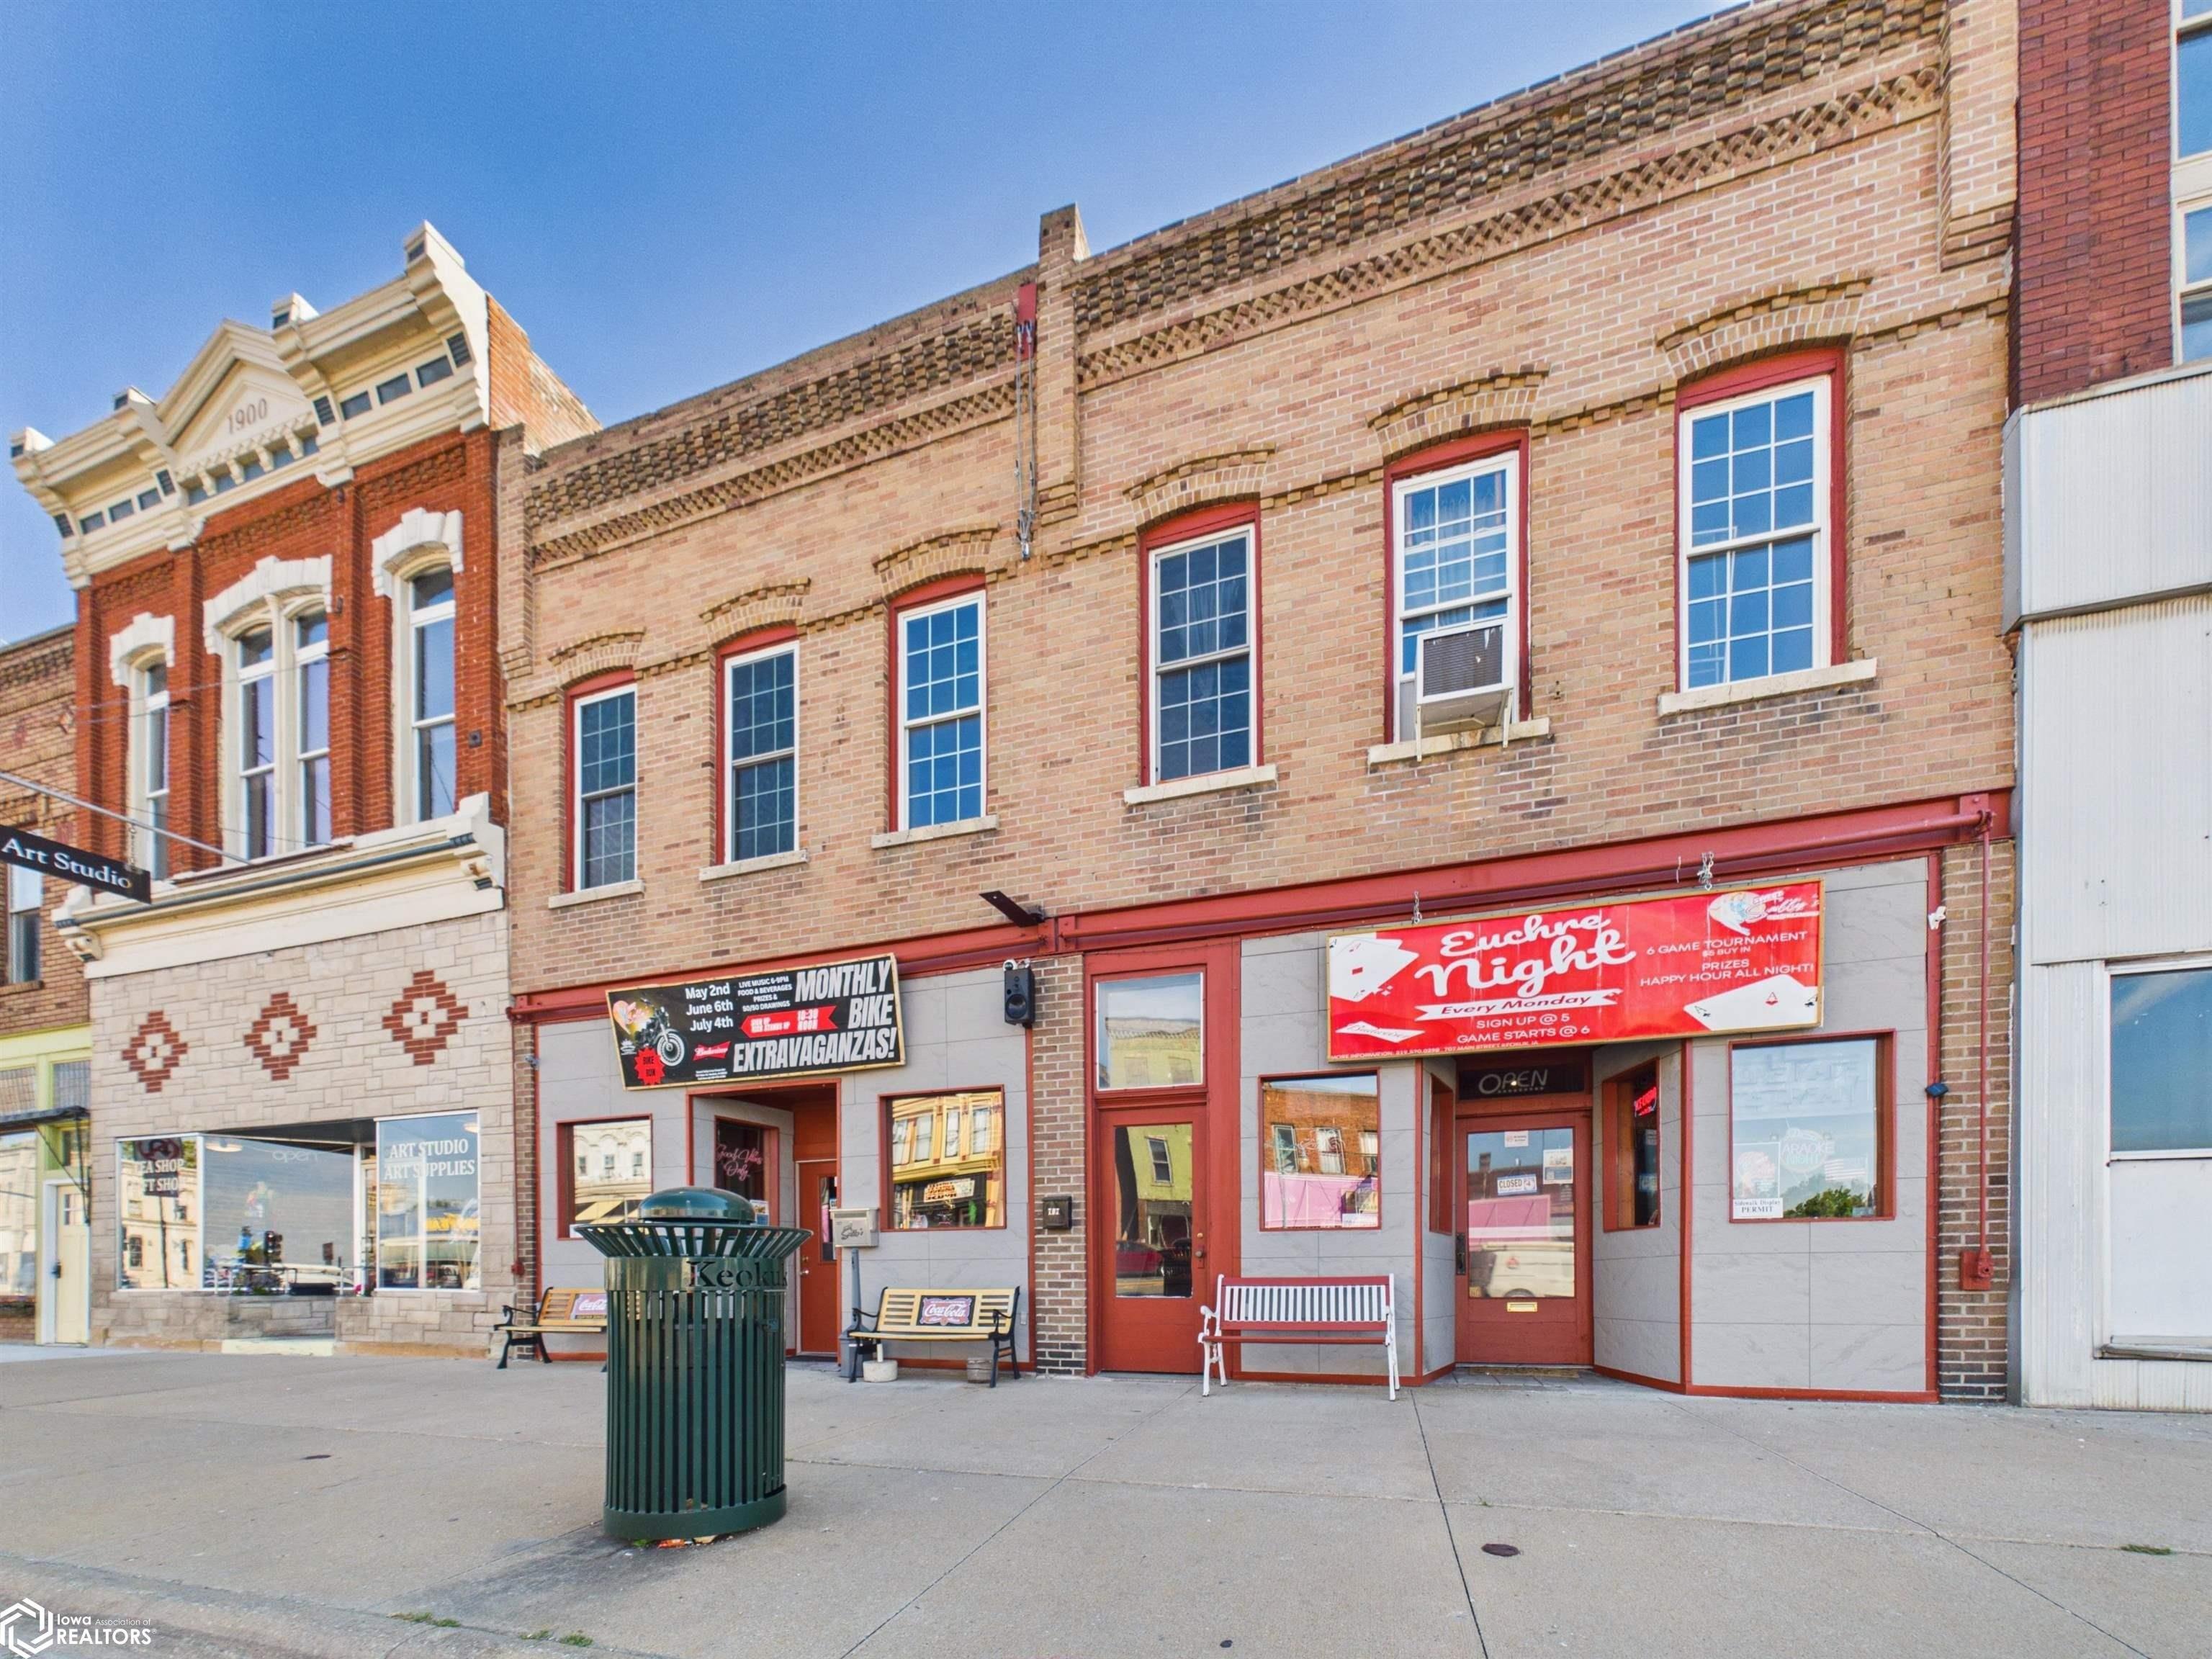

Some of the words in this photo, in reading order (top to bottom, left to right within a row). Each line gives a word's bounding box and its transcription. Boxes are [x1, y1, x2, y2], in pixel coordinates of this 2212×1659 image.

[228, 398, 267, 434] 1900
[1, 838, 48, 864] Art
[54, 852, 133, 888] Studio
[1440, 914, 1611, 956] Euchre
[1646, 947, 1655, 956] 6
[1658, 941, 1700, 954] GAME
[1704, 931, 1808, 950] TOURNAMENT
[1640, 974, 1686, 986] HAPPY
[1690, 971, 1732, 981] HOUR
[1735, 968, 1760, 978] ALL
[1764, 963, 1814, 975] NIGHT!
[1702, 958, 1750, 971] PRIZES
[685, 987, 707, 1000] May
[709, 983, 730, 996] 2nd
[752, 978, 770, 986] MUSIC
[759, 984, 793, 994] BEVERAGES
[795, 961, 891, 1002] MONTHLY
[686, 1004, 713, 1015] June
[714, 999, 733, 1012] 6th
[760, 1000, 791, 1010] DRAWINGS
[848, 994, 894, 1029] BIKE
[1442, 1004, 1497, 1015] Every
[1501, 995, 1591, 1010] Monday
[690, 1018, 712, 1033] July
[714, 1016, 733, 1028] 4th
[1476, 1018, 1512, 1029] SIGN
[1516, 1016, 1536, 1026] UP
[1539, 1014, 1557, 1025] @
[1560, 1013, 1570, 1022] 5
[1457, 1033, 1500, 1044] GAME
[1504, 1028, 1556, 1040] STARTS
[1559, 1027, 1577, 1038] @
[1581, 1025, 1590, 1034] 6
[733, 1027, 897, 1072] EXTRAVAGANZAS!
[1479, 1069, 1548, 1094] OPEN
[390, 1142, 415, 1159] ART
[418, 1138, 468, 1156] STUDIO
[156, 1159, 184, 1173] SHOP
[385, 1164, 410, 1180] ART
[413, 1159, 475, 1178] SUPPLIES
[1499, 1179, 1522, 1189] CLOSED
[687, 1262, 787, 1287] Keokuk
